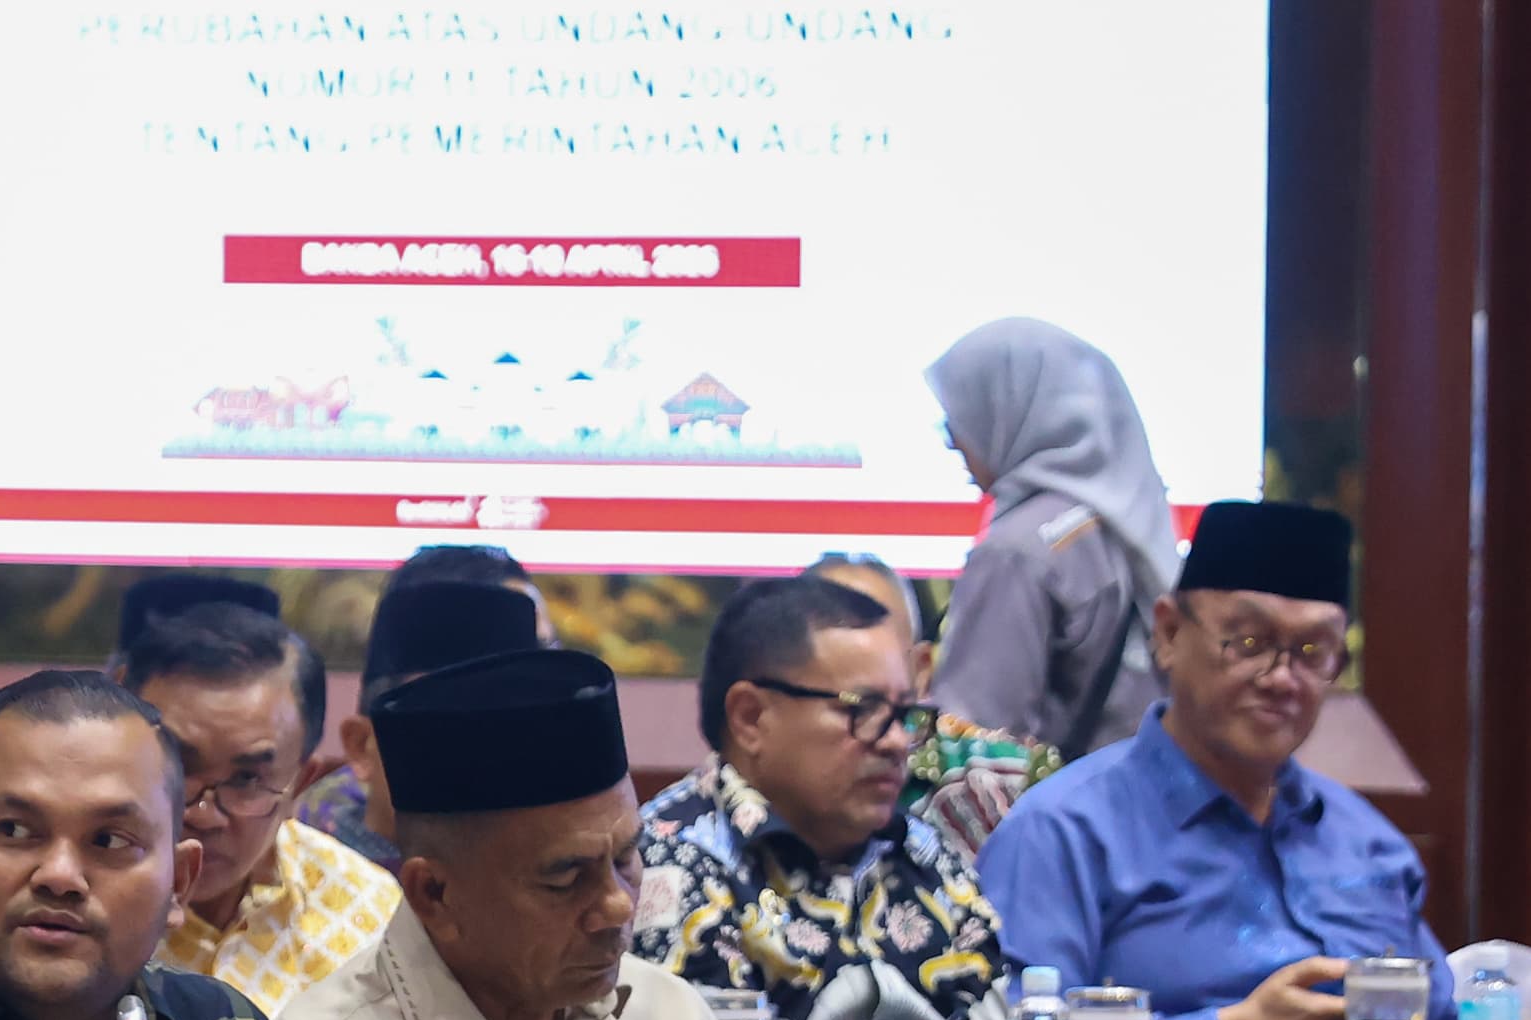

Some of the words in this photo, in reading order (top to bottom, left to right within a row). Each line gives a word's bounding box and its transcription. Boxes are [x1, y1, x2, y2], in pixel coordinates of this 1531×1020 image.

[245, 66, 418, 98] NOMOR
[505, 64, 657, 98] TAHUN
[677, 65, 778, 99] 2006
[142, 121, 350, 154] TENTANG
[370, 120, 742, 154] PEMERINTAHAN
[759, 120, 893, 154] ACEH
